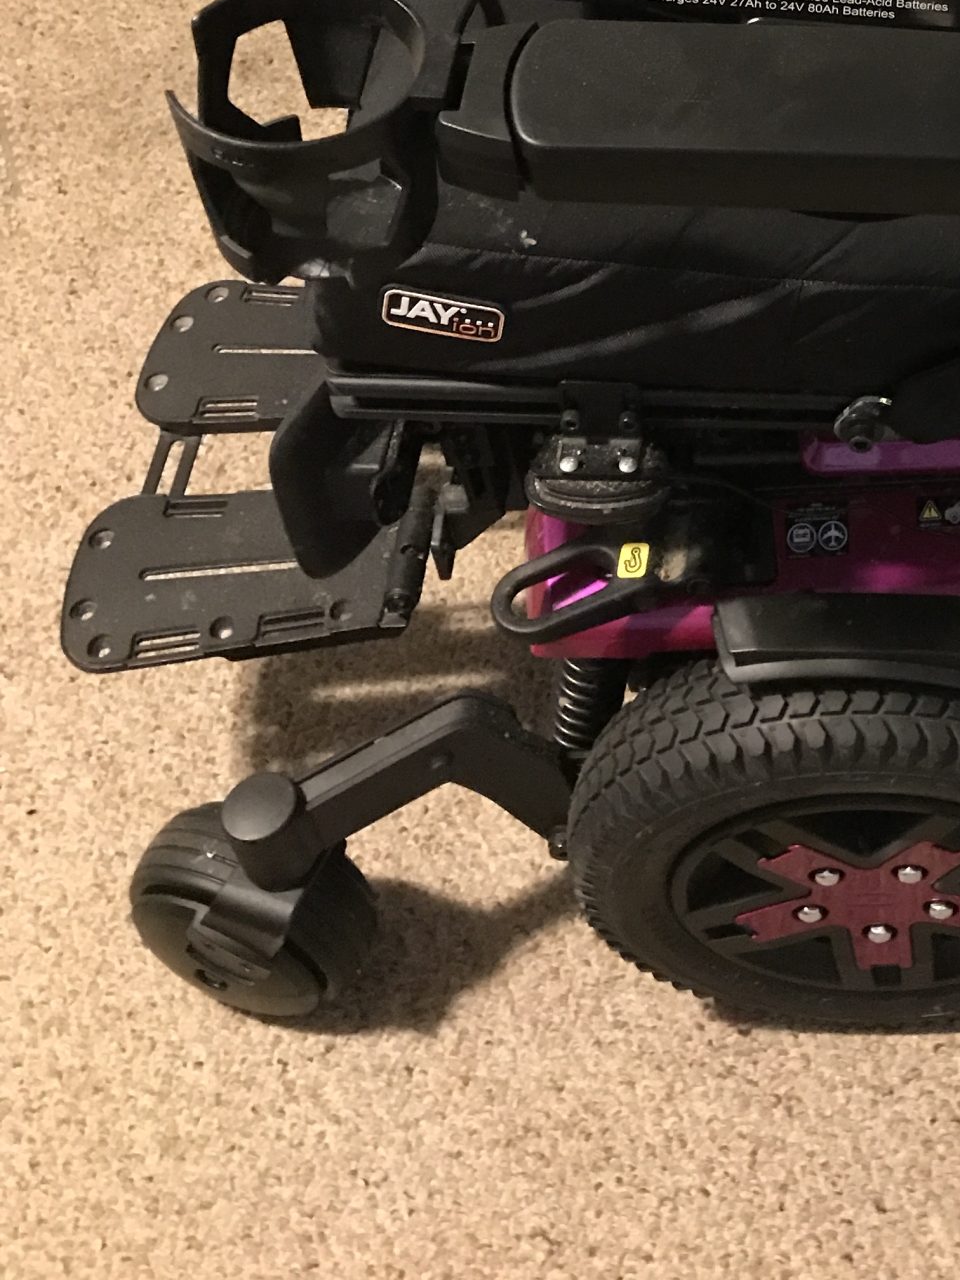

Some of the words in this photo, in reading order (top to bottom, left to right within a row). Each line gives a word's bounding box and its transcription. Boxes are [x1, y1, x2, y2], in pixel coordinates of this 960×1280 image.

[765, 0, 777, 10] to
[780, 1, 805, 12] 24V
[808, 3, 839, 14] 80Ah
[842, 6, 895, 19] Batteries
[896, 0, 948, 12] Batteries
[390, 297, 460, 326] JAY
[452, 317, 495, 338] ion
